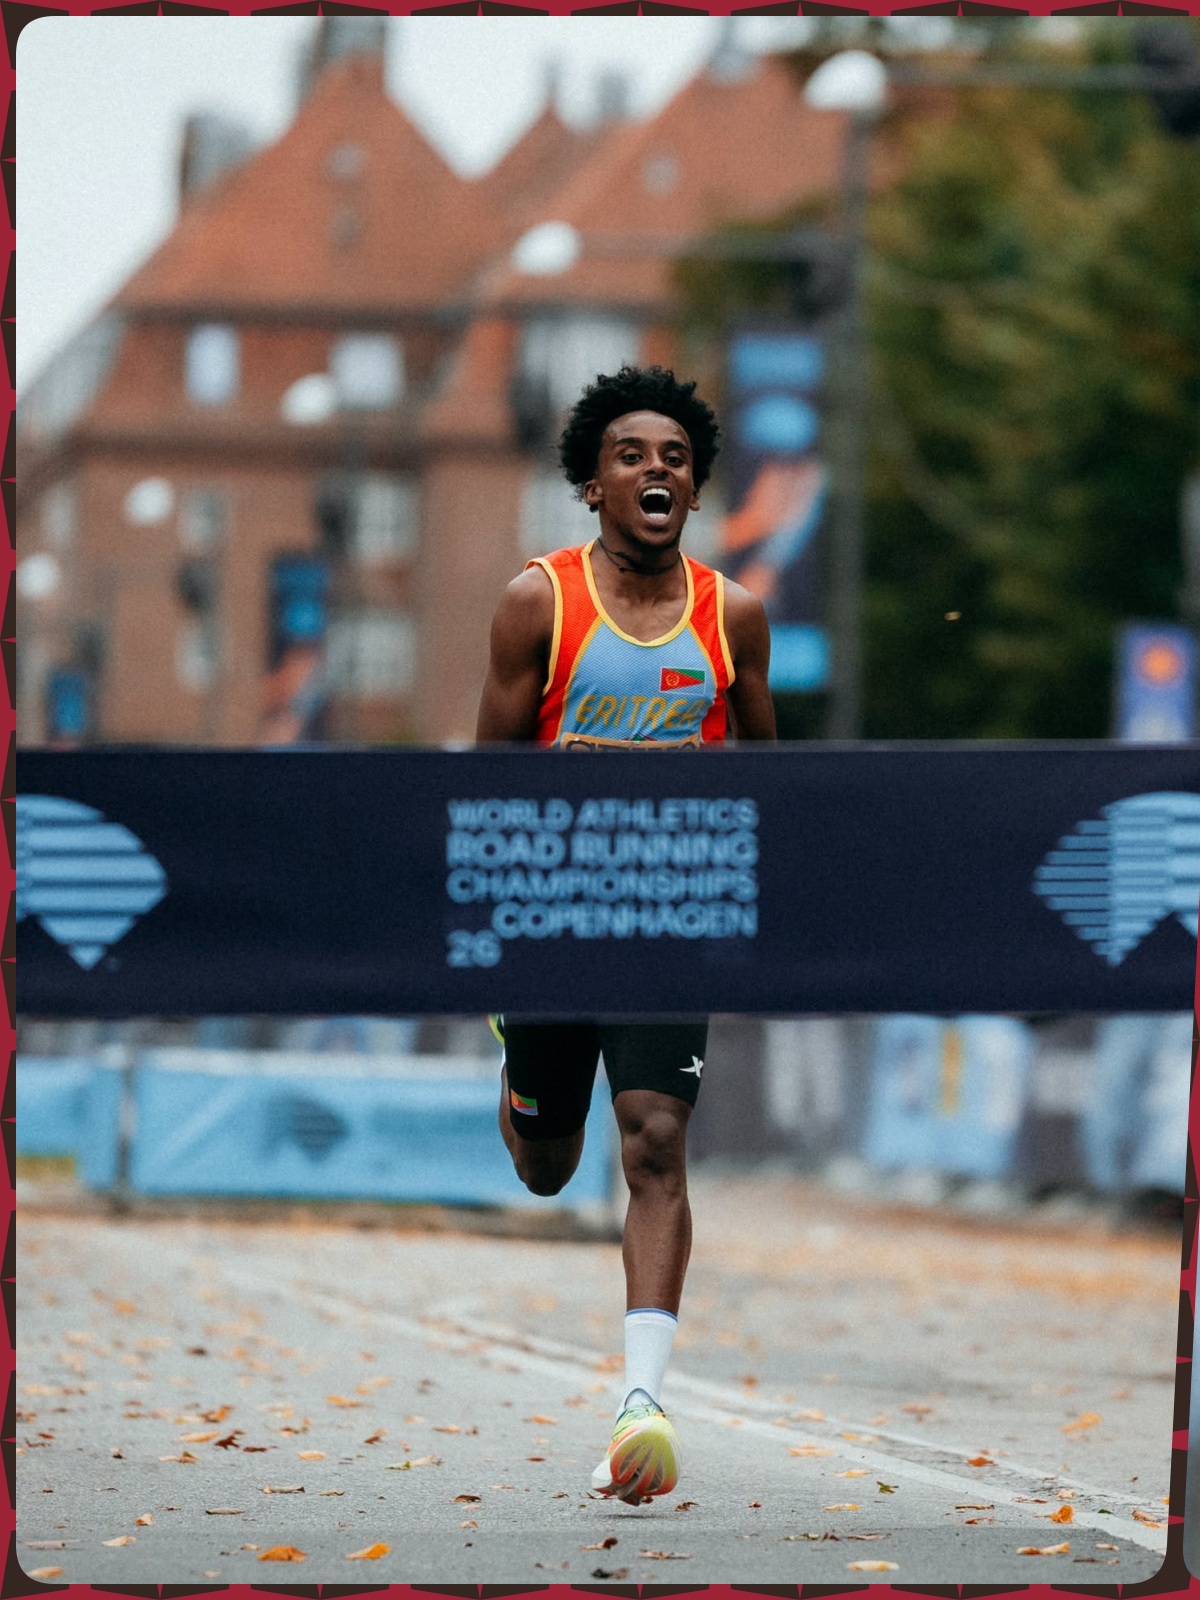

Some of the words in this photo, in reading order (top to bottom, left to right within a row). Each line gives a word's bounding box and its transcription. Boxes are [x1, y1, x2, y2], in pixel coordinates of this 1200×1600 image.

[575, 694, 708, 730] ERITREA
[448, 798, 573, 831] WORLD
[575, 798, 758, 831] ATHLETICS
[447, 830, 566, 868] ROAD
[570, 830, 758, 868] RUNNING
[446, 867, 758, 904] CHAMPIONSHIPS
[491, 901, 758, 939] COPENHAGEN
[446, 930, 501, 967] 26
